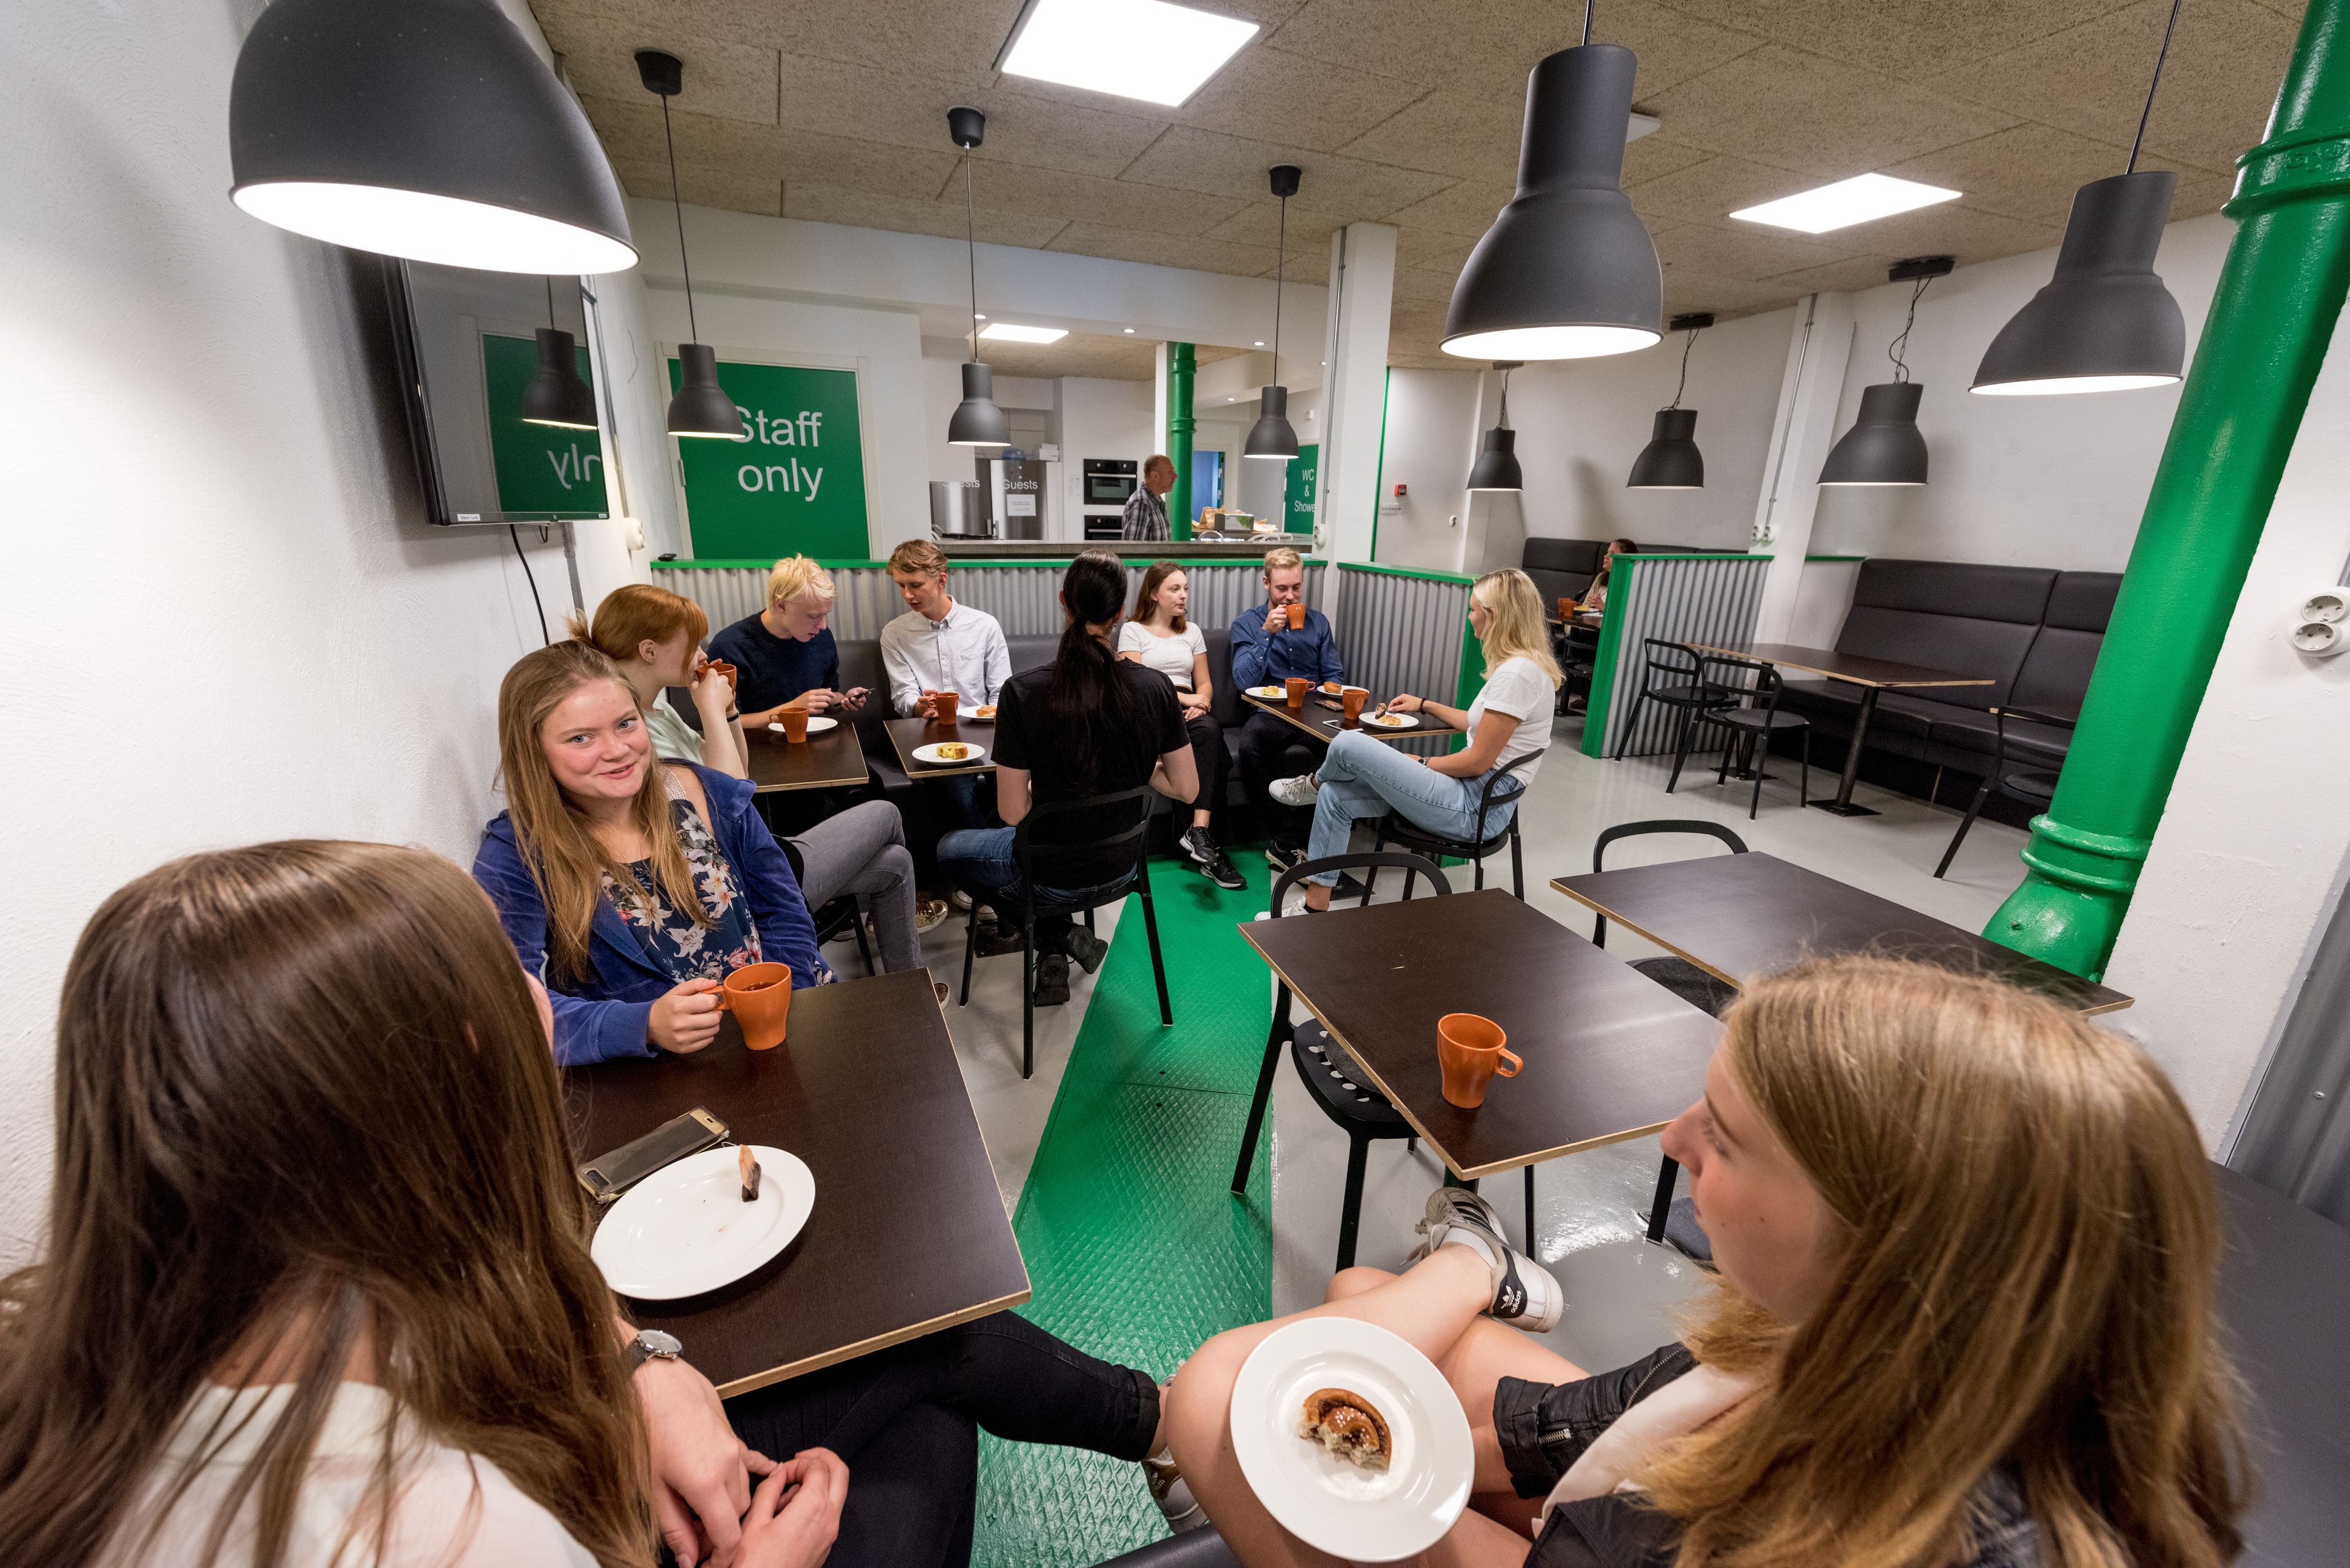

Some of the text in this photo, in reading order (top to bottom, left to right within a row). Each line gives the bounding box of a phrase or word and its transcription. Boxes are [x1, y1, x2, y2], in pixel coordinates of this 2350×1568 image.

[730, 405, 822, 447] Staff
[738, 457, 823, 502] only
[1302, 469, 1315, 481] WC
[1003, 479, 1038, 490] Guests
[1304, 485, 1310, 497] &
[1294, 500, 1315, 512] Showe
[1510, 1290, 1521, 1313] adidas
